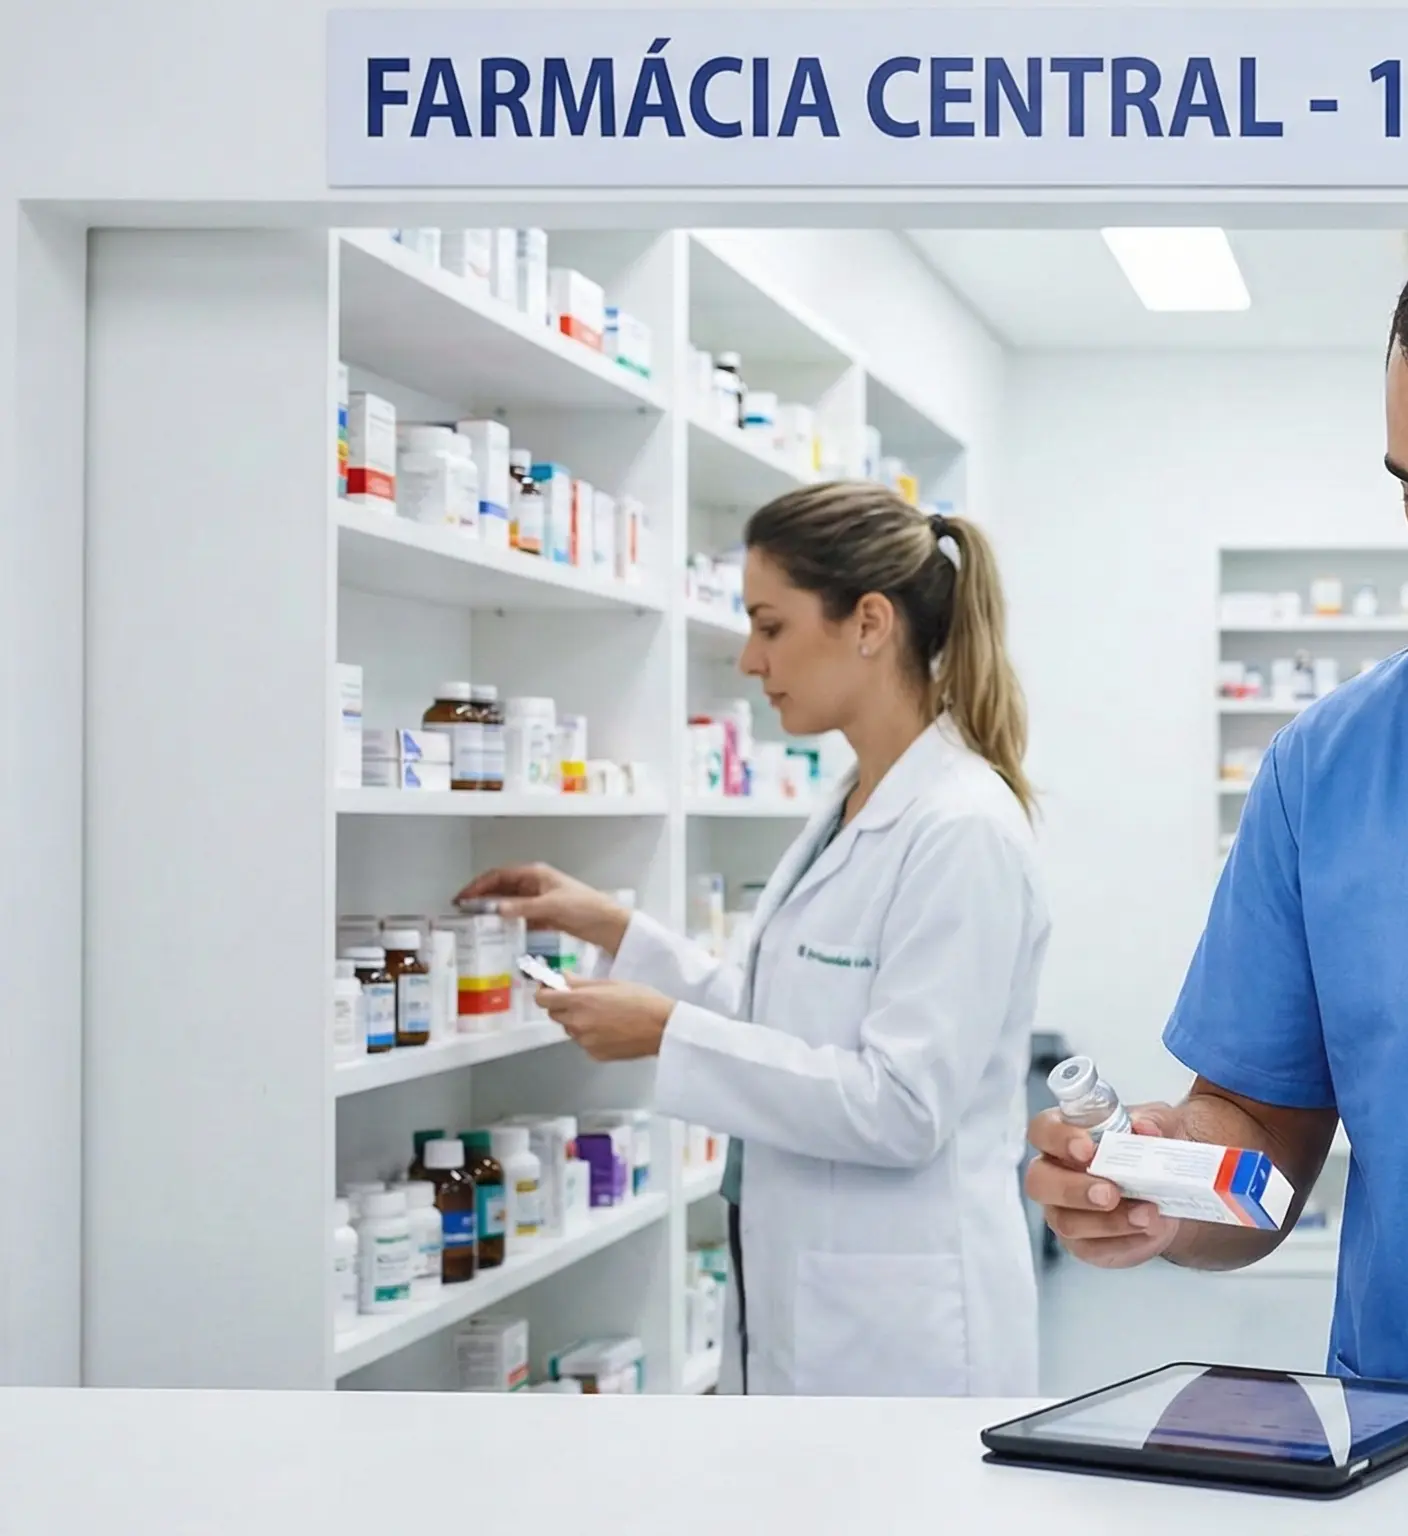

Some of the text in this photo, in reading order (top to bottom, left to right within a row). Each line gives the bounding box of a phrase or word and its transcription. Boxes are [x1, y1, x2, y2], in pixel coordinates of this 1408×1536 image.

[368, 39, 837, 138] FARMÁCIA
[867, 57, 1282, 138] CENTRAL
[1310, 99, 1338, 112] -
